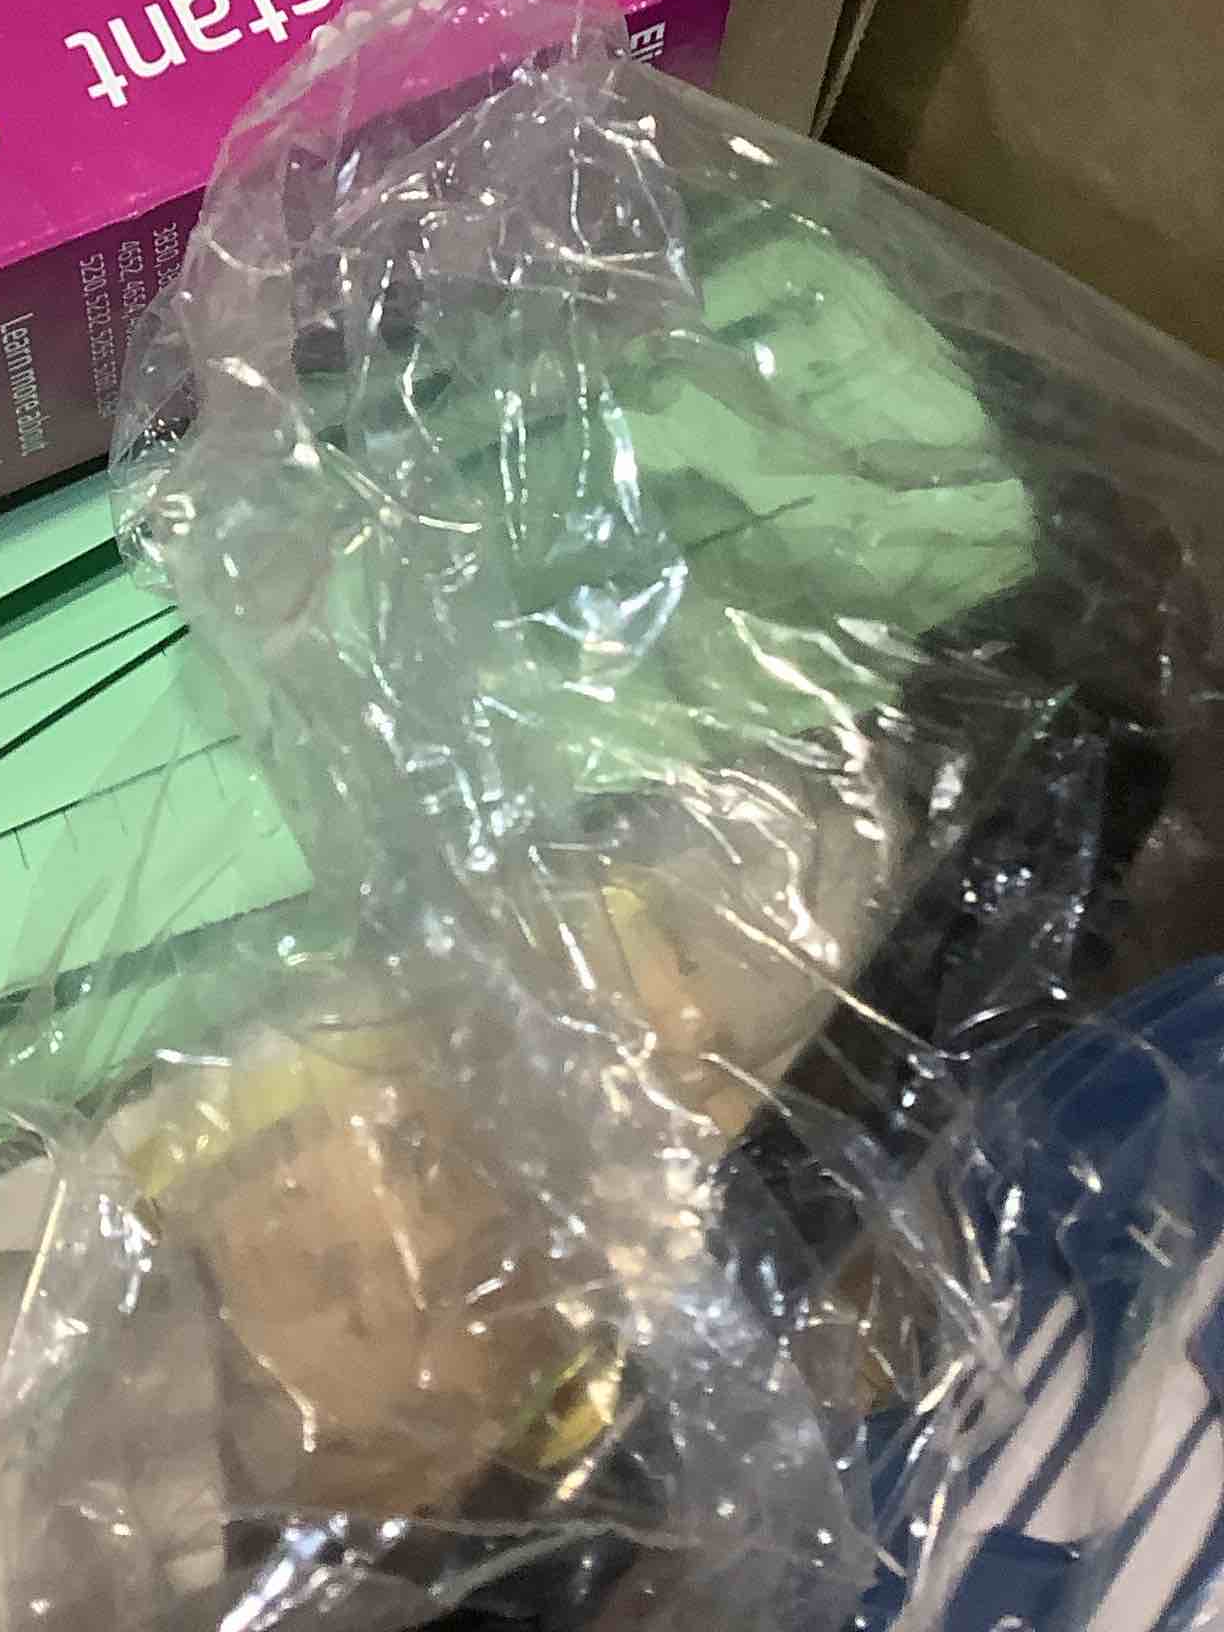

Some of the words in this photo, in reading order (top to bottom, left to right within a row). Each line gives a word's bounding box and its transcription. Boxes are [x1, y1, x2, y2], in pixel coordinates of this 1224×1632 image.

[0, 312, 34, 372] Learn
[10, 369, 39, 415] more
[16, 411, 51, 457] about
